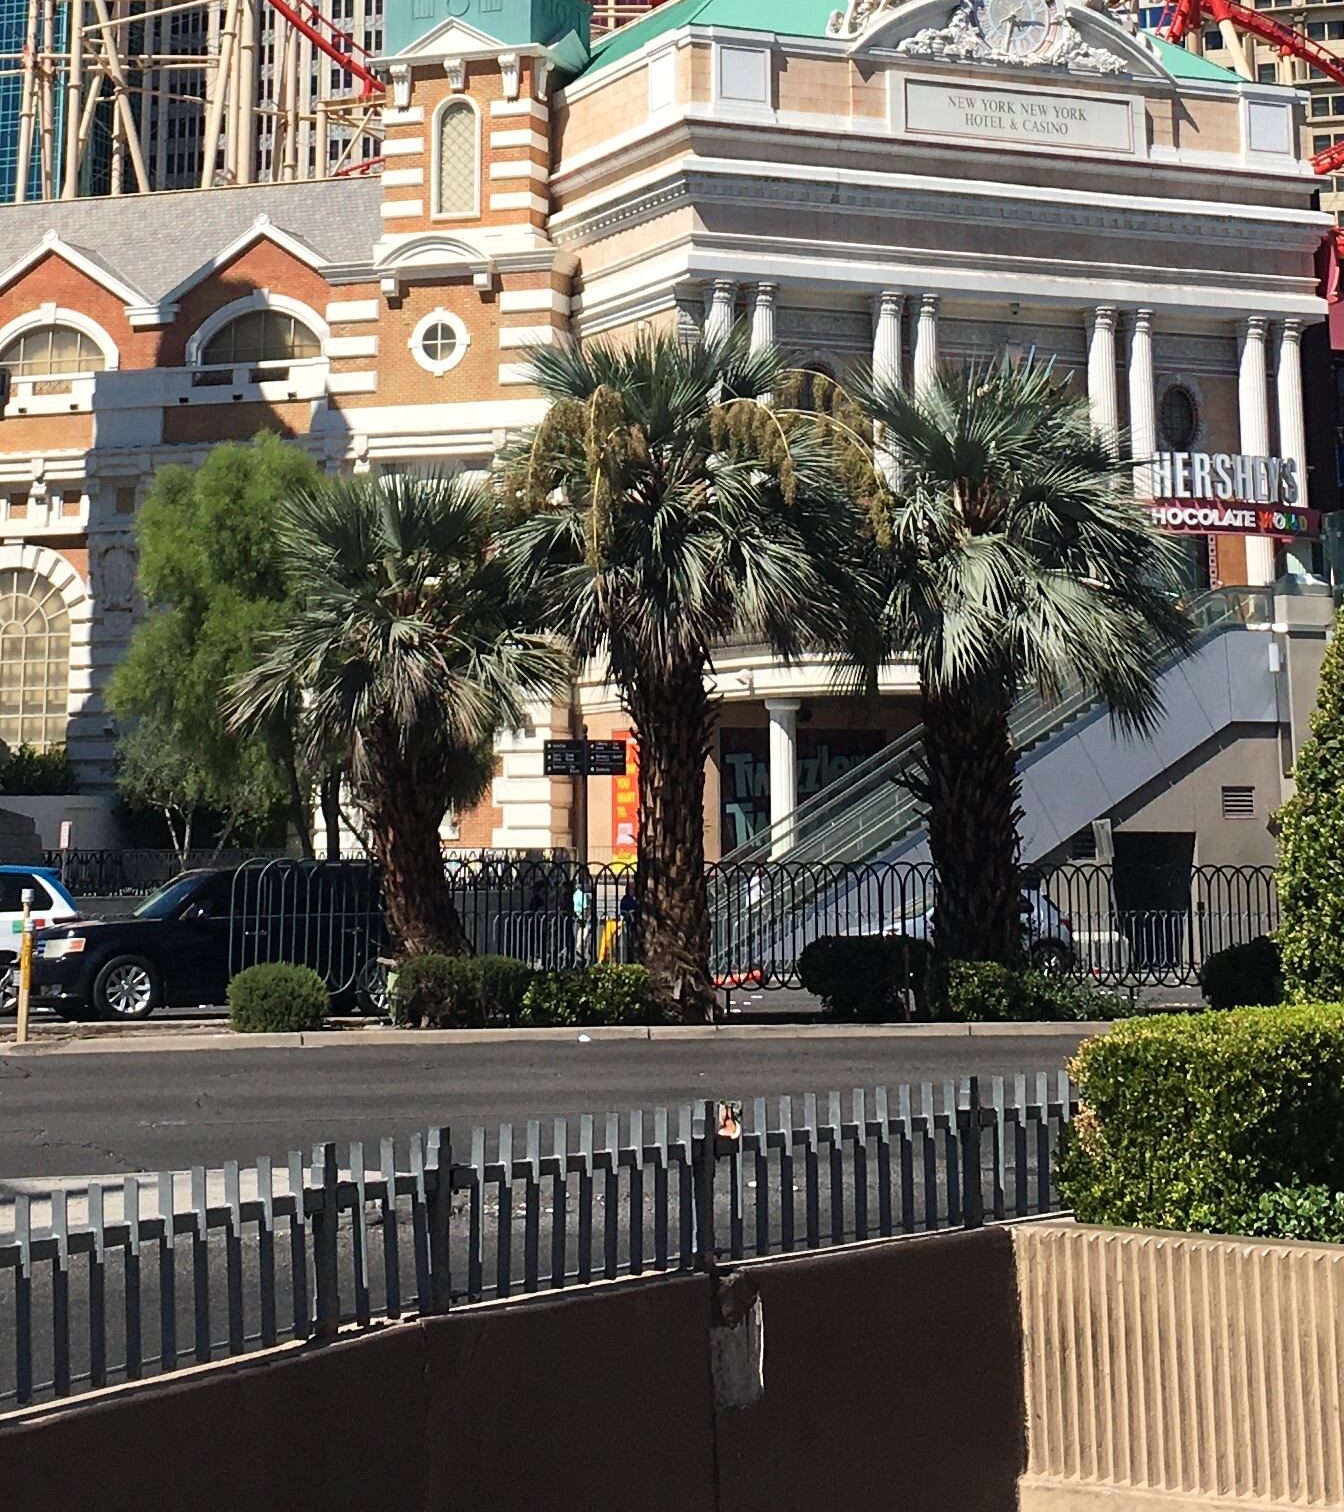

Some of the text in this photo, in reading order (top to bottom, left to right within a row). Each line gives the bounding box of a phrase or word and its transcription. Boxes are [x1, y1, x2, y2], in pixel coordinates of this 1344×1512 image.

[947, 95, 1088, 121] NEW YORK NEW YORK
[965, 113, 1069, 136] HOTEL & CASINO
[1152, 451, 1299, 505] HERSHEY'S
[1152, 507, 1256, 528] HOCOLATE
